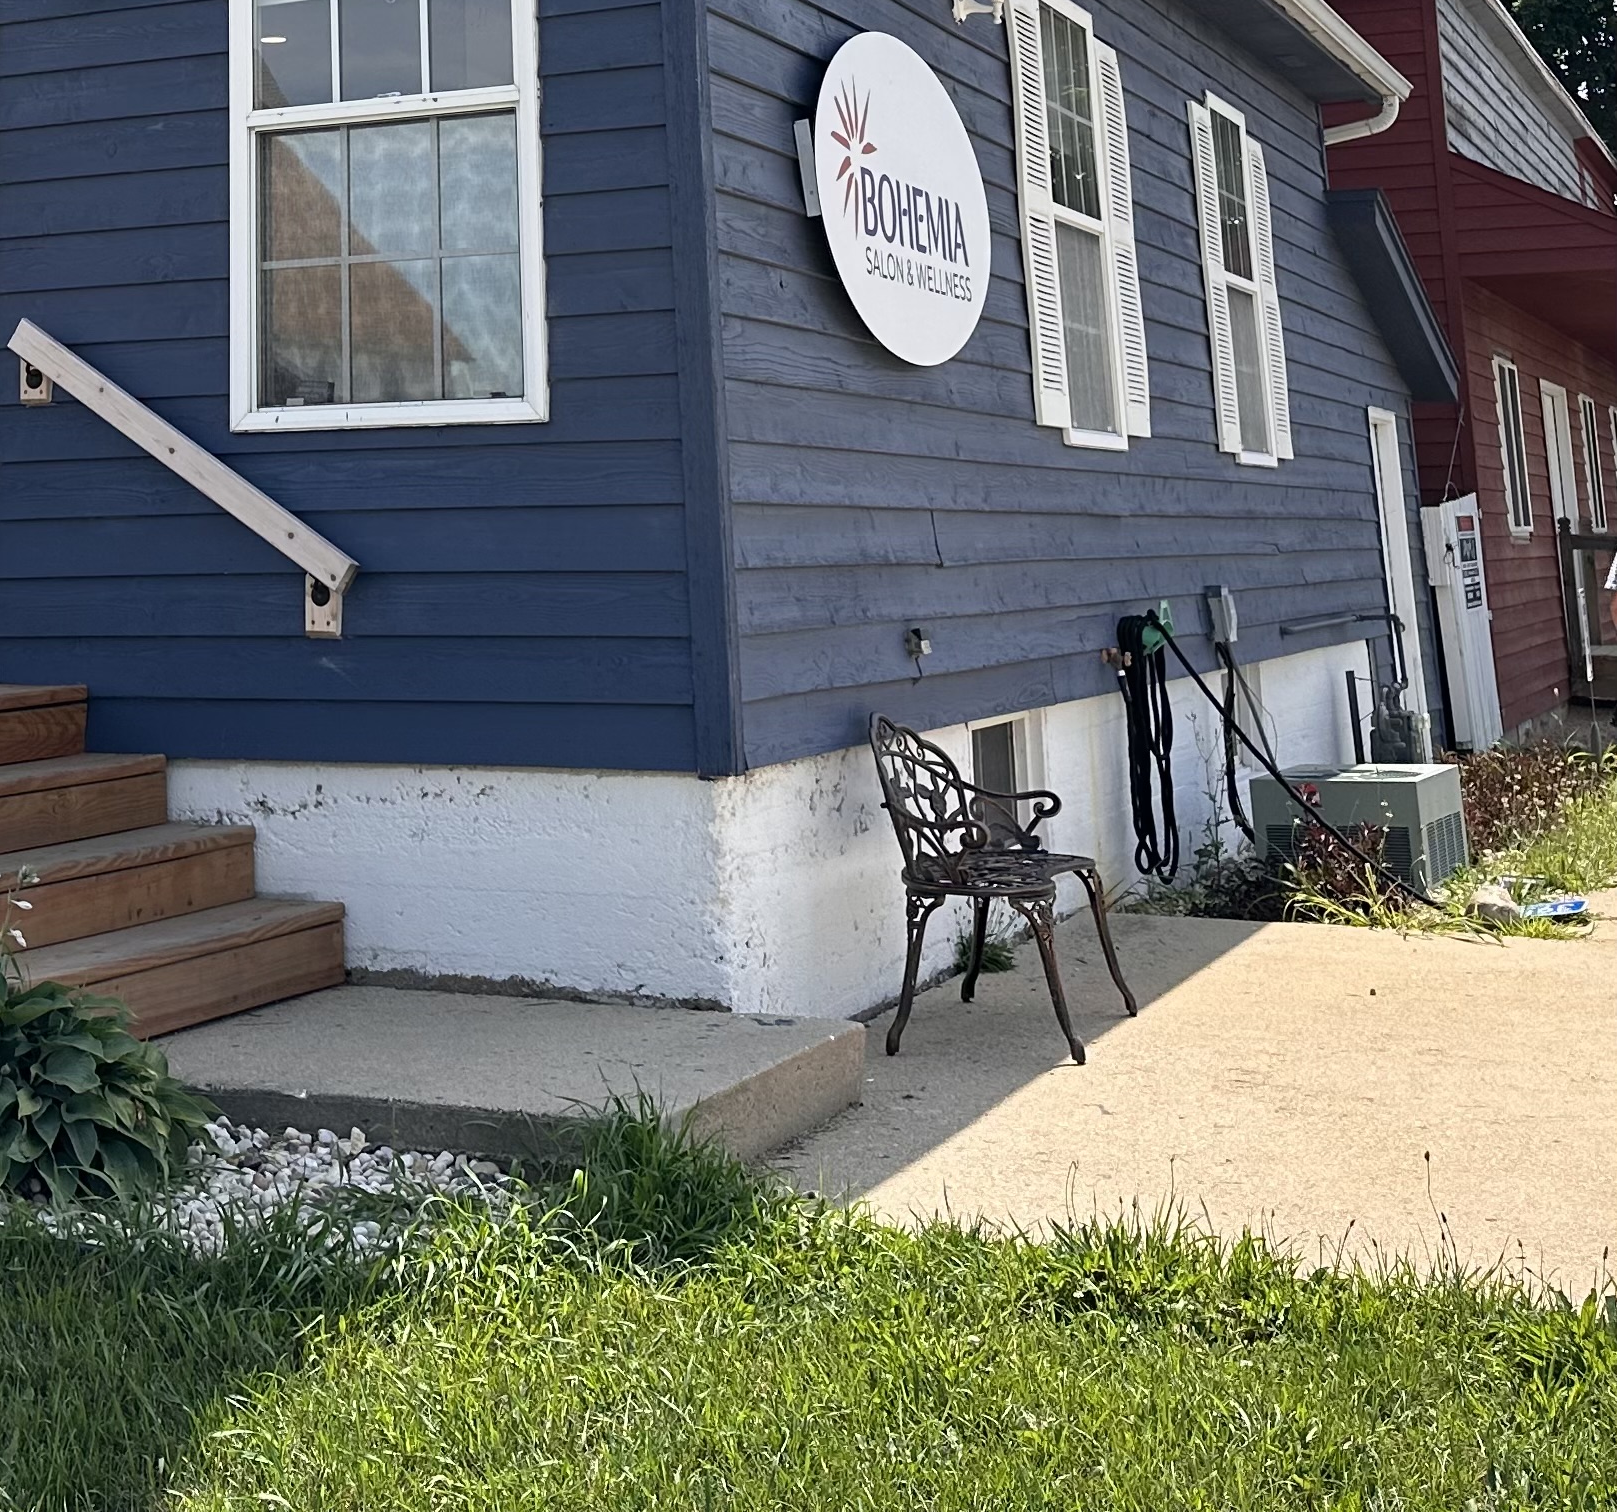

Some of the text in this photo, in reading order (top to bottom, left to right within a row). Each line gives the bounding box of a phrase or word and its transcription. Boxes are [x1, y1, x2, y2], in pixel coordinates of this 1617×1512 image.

[860, 166, 970, 267] BOHEMIA
[865, 246, 972, 302] SALON & WELLNESS
